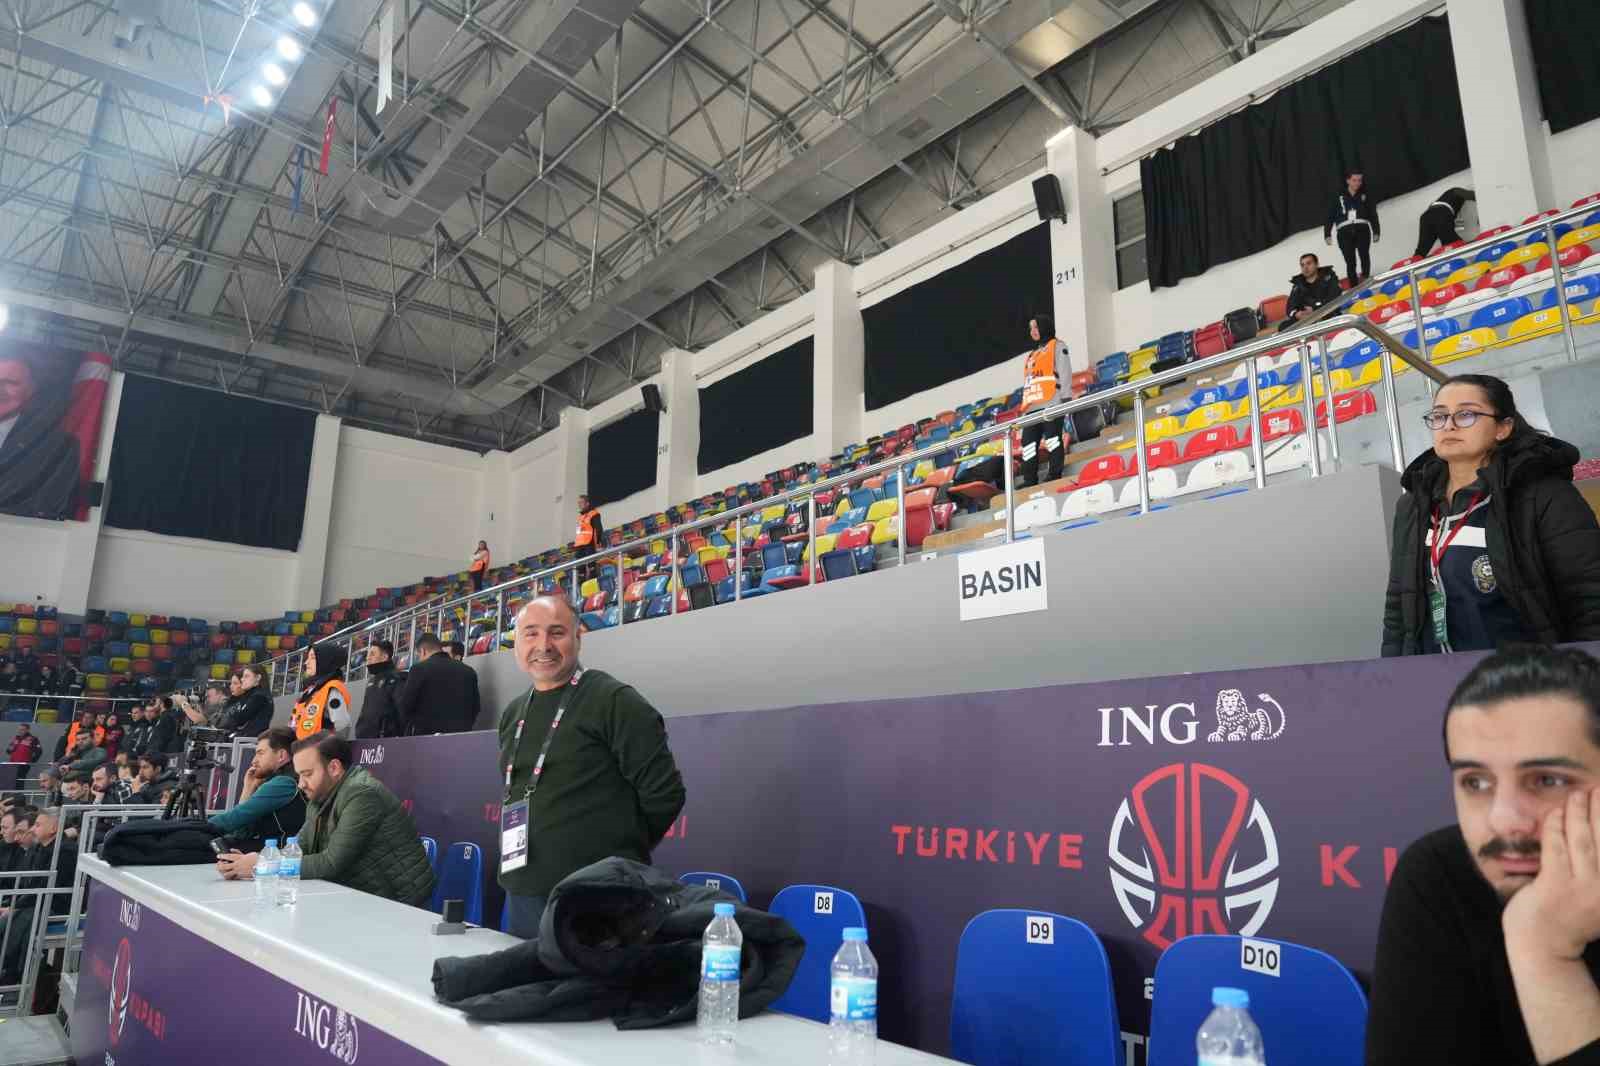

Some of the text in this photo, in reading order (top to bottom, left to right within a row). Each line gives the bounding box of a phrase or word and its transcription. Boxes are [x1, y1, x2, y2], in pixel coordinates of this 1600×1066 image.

[1056, 267, 1075, 285] 211
[961, 560, 1041, 599] BASIN
[1097, 702, 1200, 746] ING
[360, 749, 375, 764] ING
[817, 895, 830, 911] D8
[1031, 922, 1049, 939] D9
[1244, 945, 1277, 969] D10
[294, 991, 330, 1048] ING
